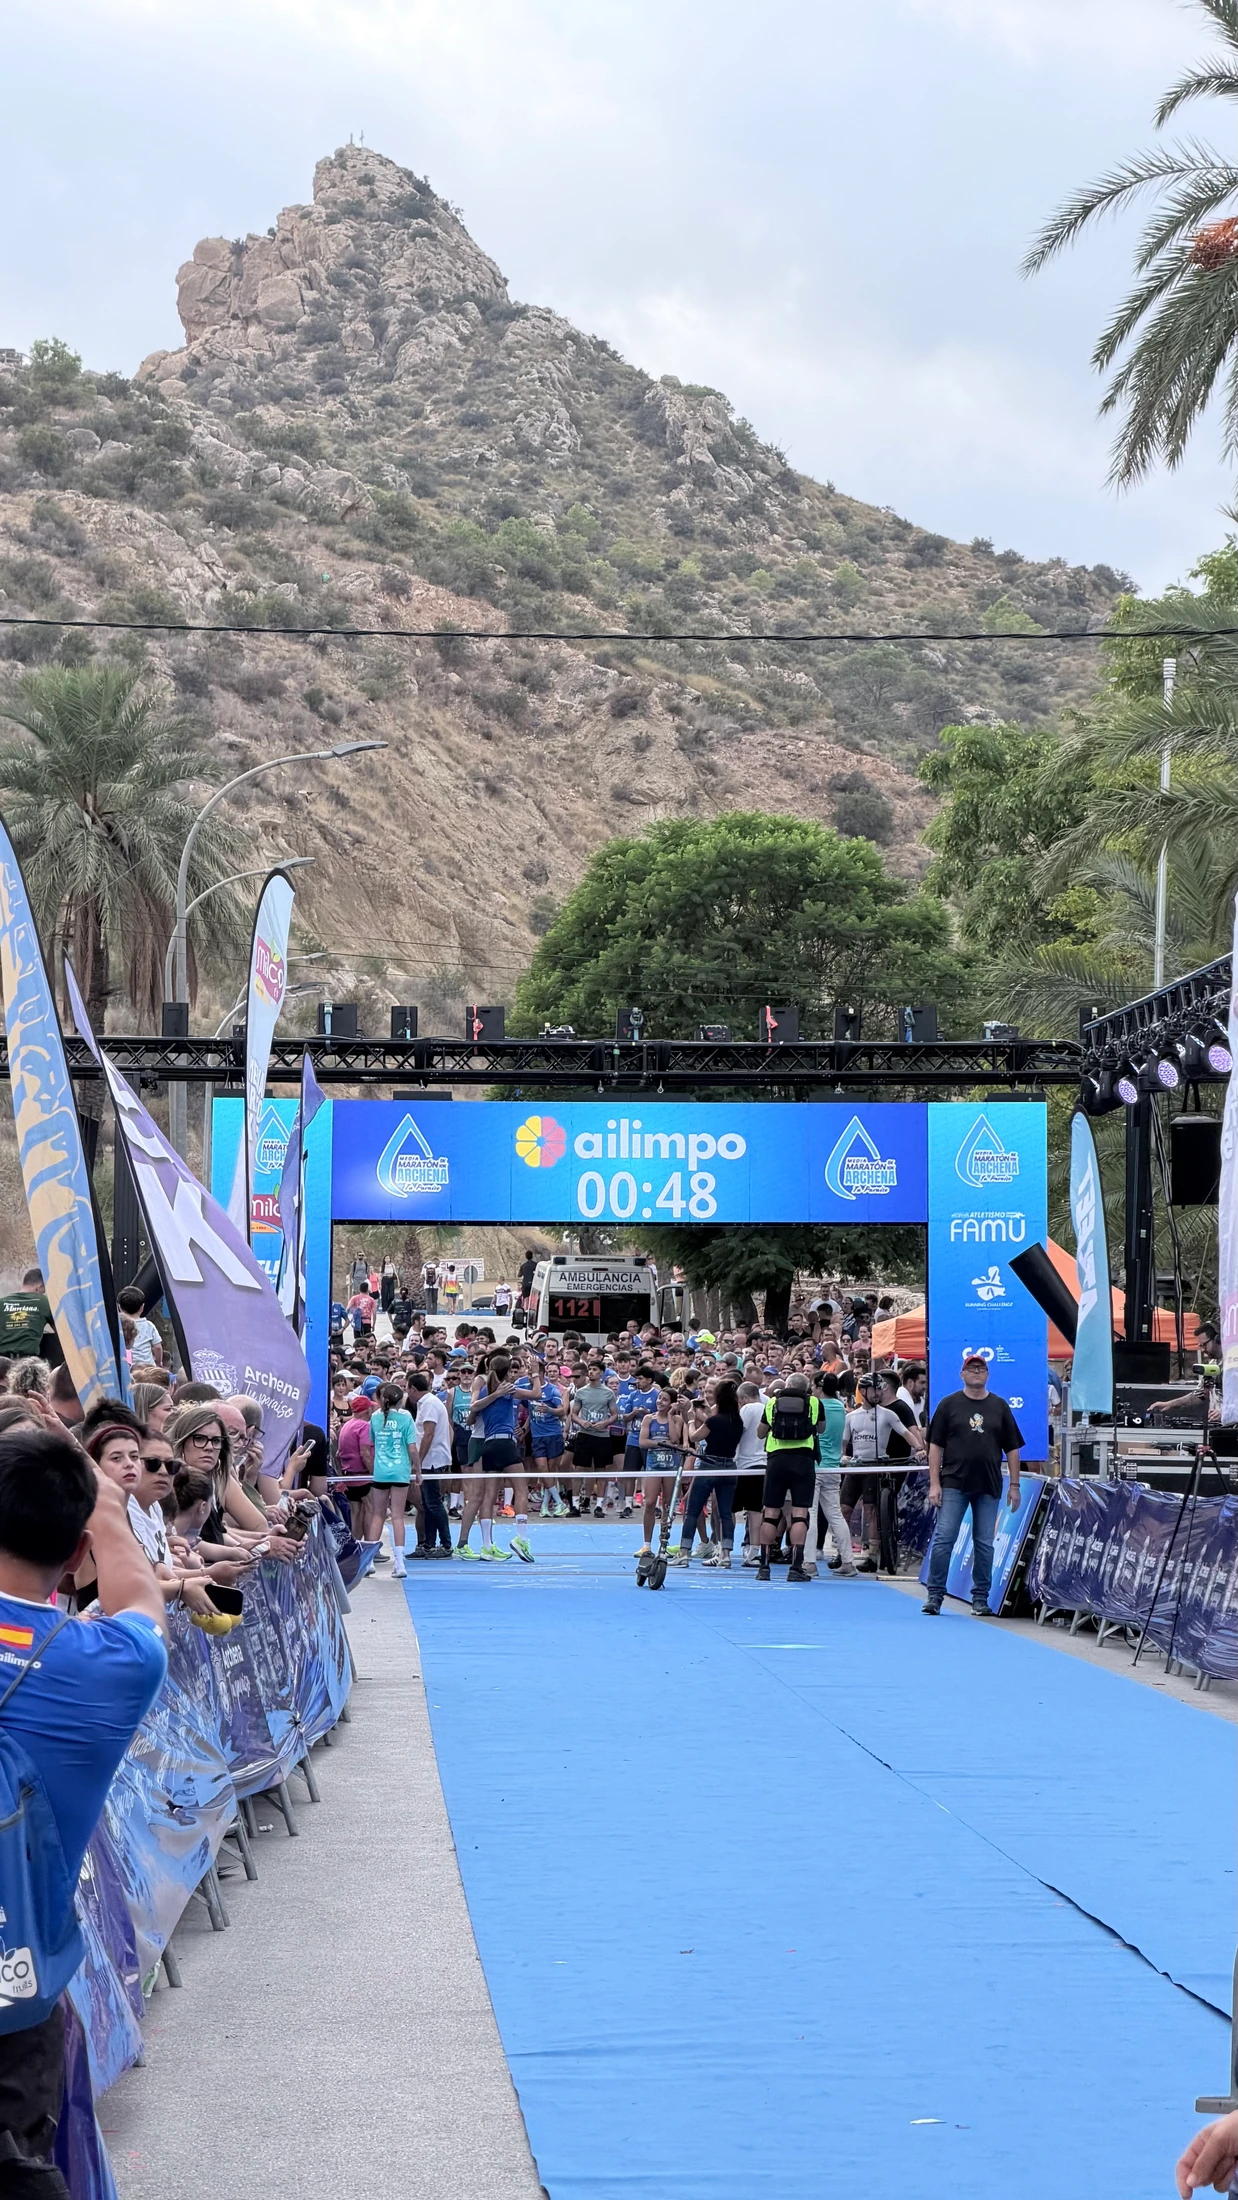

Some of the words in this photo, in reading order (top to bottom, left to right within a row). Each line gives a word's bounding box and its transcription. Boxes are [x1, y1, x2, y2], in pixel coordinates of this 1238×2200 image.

[574, 1118, 747, 1171] ailimpo
[262, 1151, 285, 1161] ARCH
[974, 1154, 1010, 1162] MARATÓN
[398, 1160, 438, 1168] MARATÓN
[846, 1162, 886, 1170] MARATÓN
[974, 1162, 1017, 1174] ARCHENA
[397, 1169, 447, 1182] ARCHENA
[845, 1171, 895, 1184] ARCHENA
[577, 1171, 717, 1218] 00:48
[950, 1219, 1026, 1242] FAMU
[558, 1272, 642, 1283] AMBULANCIA
[566, 1284, 633, 1292] EMERGENCIAS
[554, 1299, 589, 1317] 112
[244, 1366, 300, 1400] Archena
[656, 1453, 673, 1462] 2017
[13, 1980, 33, 1994] fruits
